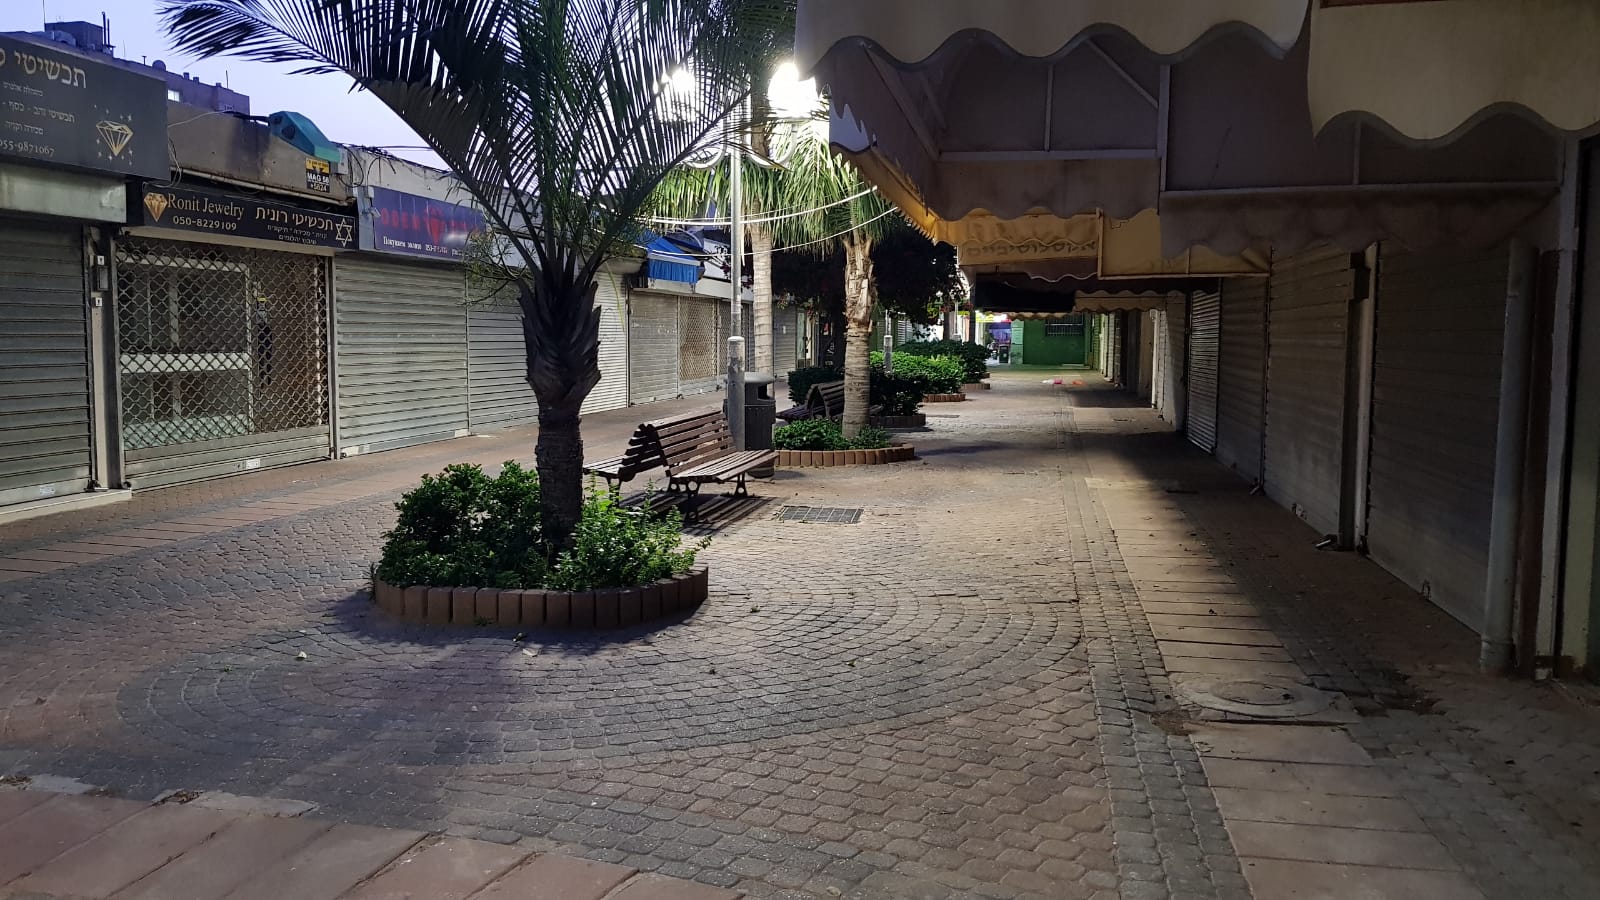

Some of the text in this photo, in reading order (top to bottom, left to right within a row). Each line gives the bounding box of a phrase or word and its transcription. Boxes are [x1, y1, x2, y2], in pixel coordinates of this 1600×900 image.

[14, 50, 87, 89] תכשיטי
[168, 192, 244, 220] Ronit Jewelry
[255, 207, 334, 231] תכשיטי רונית
[173, 215, 237, 230] 050-8229109
